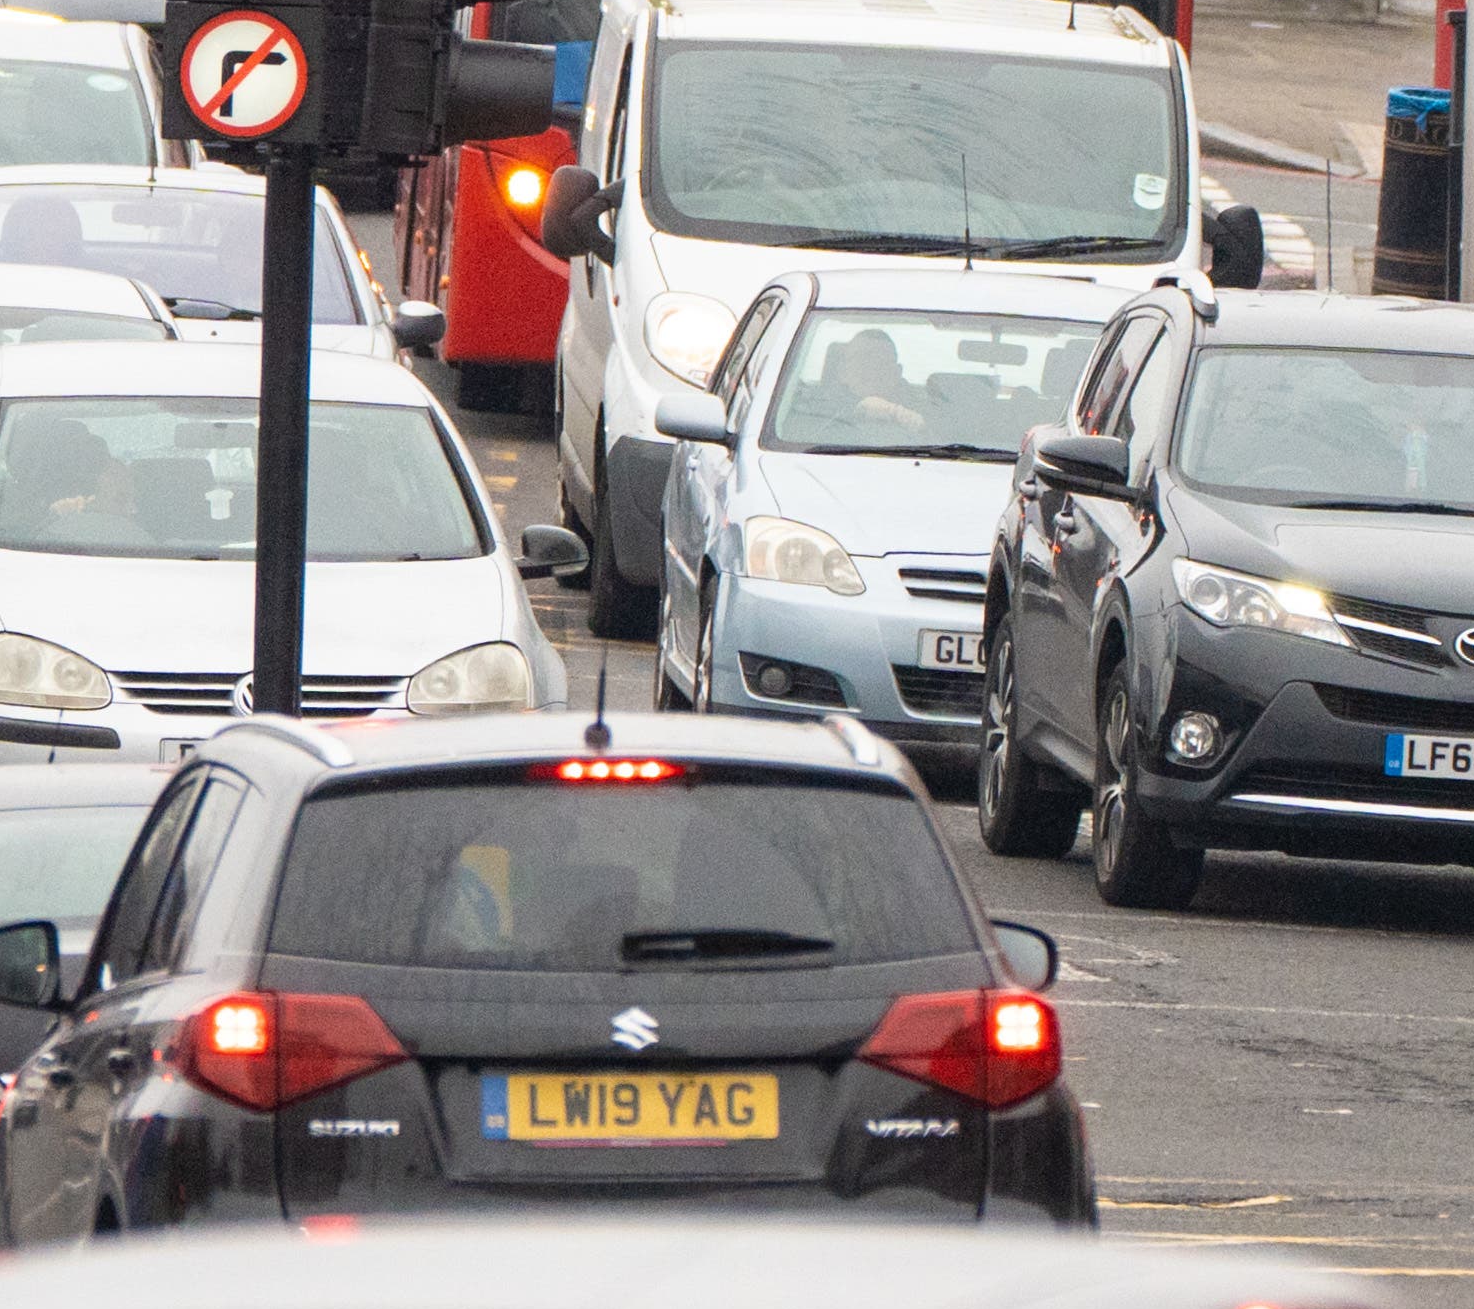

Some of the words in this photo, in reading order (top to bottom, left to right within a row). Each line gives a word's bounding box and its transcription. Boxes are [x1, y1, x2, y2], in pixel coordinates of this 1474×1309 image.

[529, 1082, 639, 1128] LW19
[657, 1082, 756, 1128] YAG
[308, 1118, 400, 1137] SUZUKI
[865, 1118, 960, 1137] VITARA
